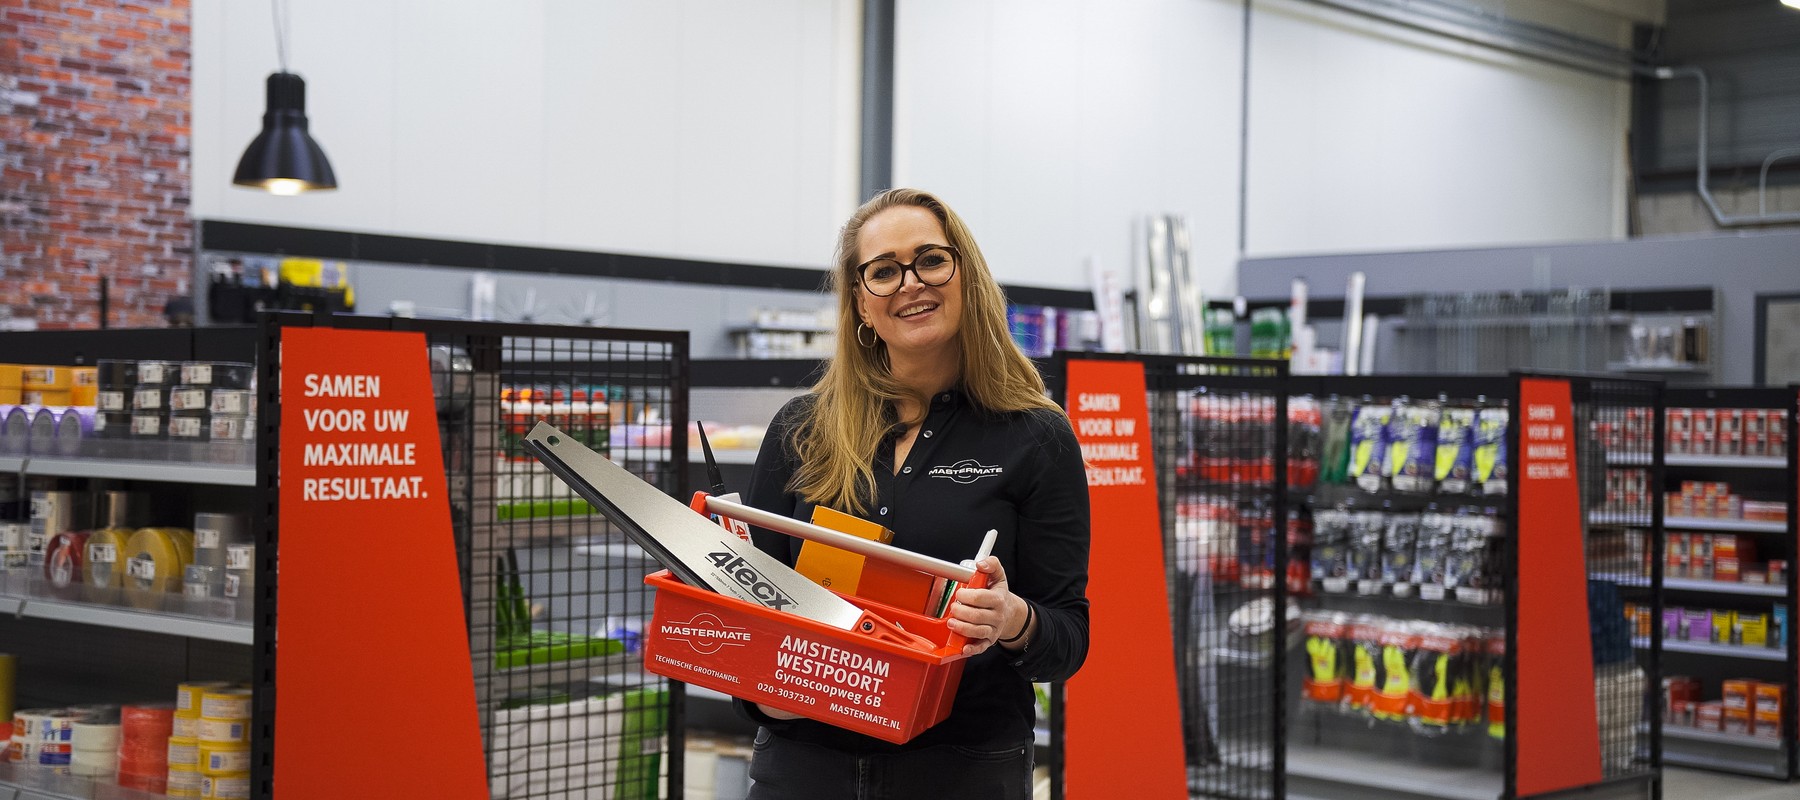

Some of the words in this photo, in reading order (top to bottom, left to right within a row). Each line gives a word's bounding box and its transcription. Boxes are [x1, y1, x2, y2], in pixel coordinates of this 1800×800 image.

[304, 374, 380, 398] SAMEN
[1078, 393, 1120, 412] SAMEN
[303, 408, 366, 432] VOOR
[374, 409, 409, 432] UW
[1078, 418, 1113, 437] VOOR
[1114, 418, 1136, 437] UW
[303, 443, 416, 466] MAXIMALE
[929, 467, 1003, 475] MASTERMATE
[1085, 467, 1147, 486] ESULTAAT.
[303, 476, 428, 501] RESULTAAT.
[708, 552, 791, 611] 4tecx
[661, 625, 751, 641] MASTERMATE
[780, 634, 890, 678] AMSTERDAM
[655, 654, 693, 670] TECHNISCHE
[693, 665, 741, 684] GROOTHANDEL.
[777, 651, 886, 696] WESTPOORT.
[757, 682, 816, 706] 020-3037320
[775, 669, 863, 705] Gyroscoopweg
[864, 694, 882, 708] 6B
[829, 702, 901, 730] MASTERMATE.NL
